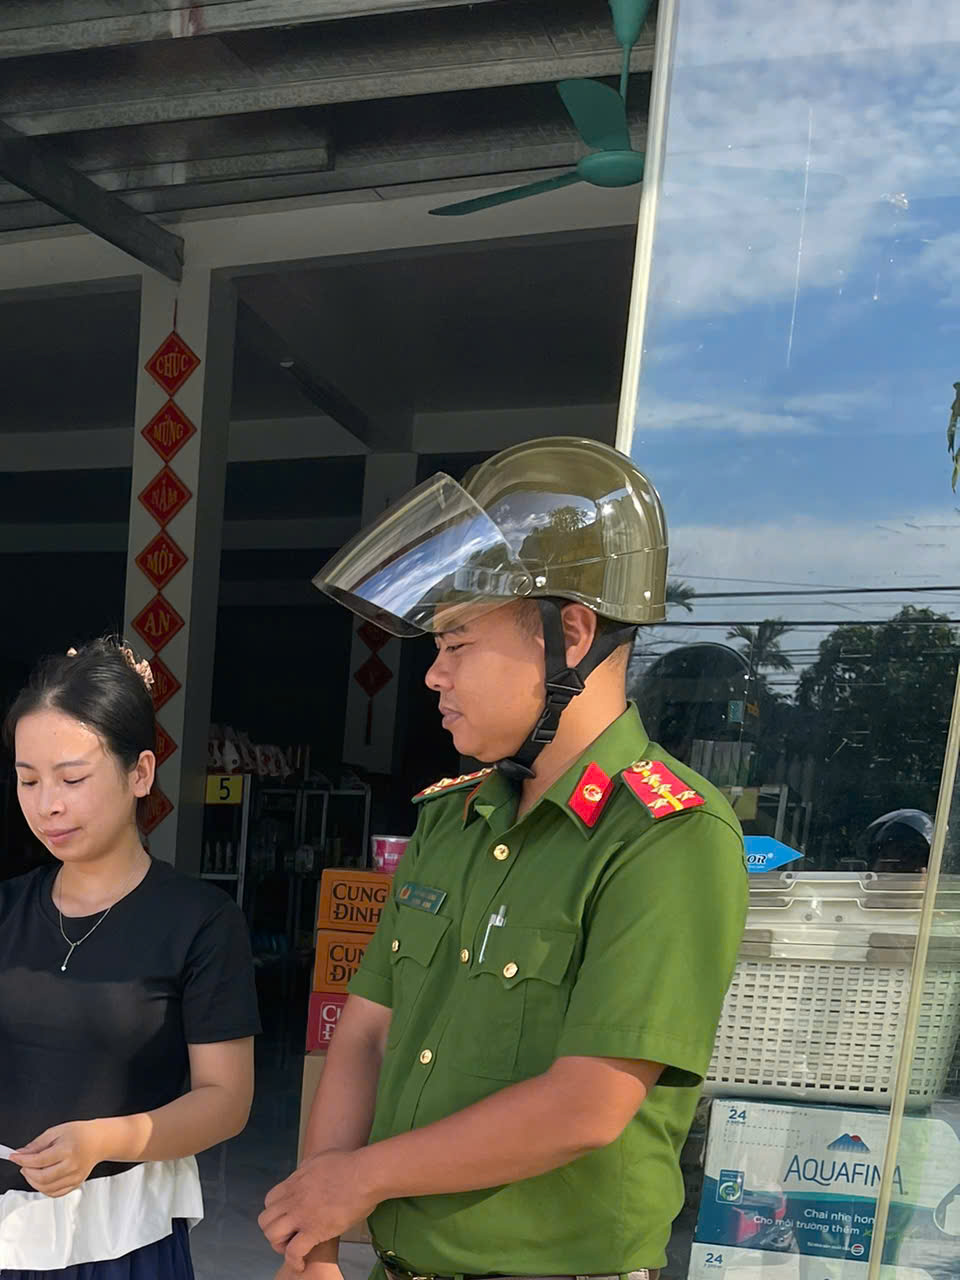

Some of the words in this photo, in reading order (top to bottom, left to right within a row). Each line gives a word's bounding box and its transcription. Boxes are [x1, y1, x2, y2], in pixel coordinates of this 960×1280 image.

[156, 346, 189, 378] CHÚC
[146, 543, 174, 575] MỚI
[143, 609, 172, 637] AN
[218, 777, 231, 801] 5
[332, 882, 387, 904] CUNG
[332, 902, 383, 923] ĐÌNH
[727, 1108, 747, 1121] 24
[783, 1154, 904, 1196] AQUAFINA
[753, 1215, 773, 1226] Cho
[796, 1220, 829, 1233] trường
[831, 1224, 860, 1236] thêm
[803, 1208, 828, 1220] Chai
[830, 1212, 853, 1223] nhẹ
[853, 1214, 876, 1225] hơn
[704, 1252, 723, 1264] 24
